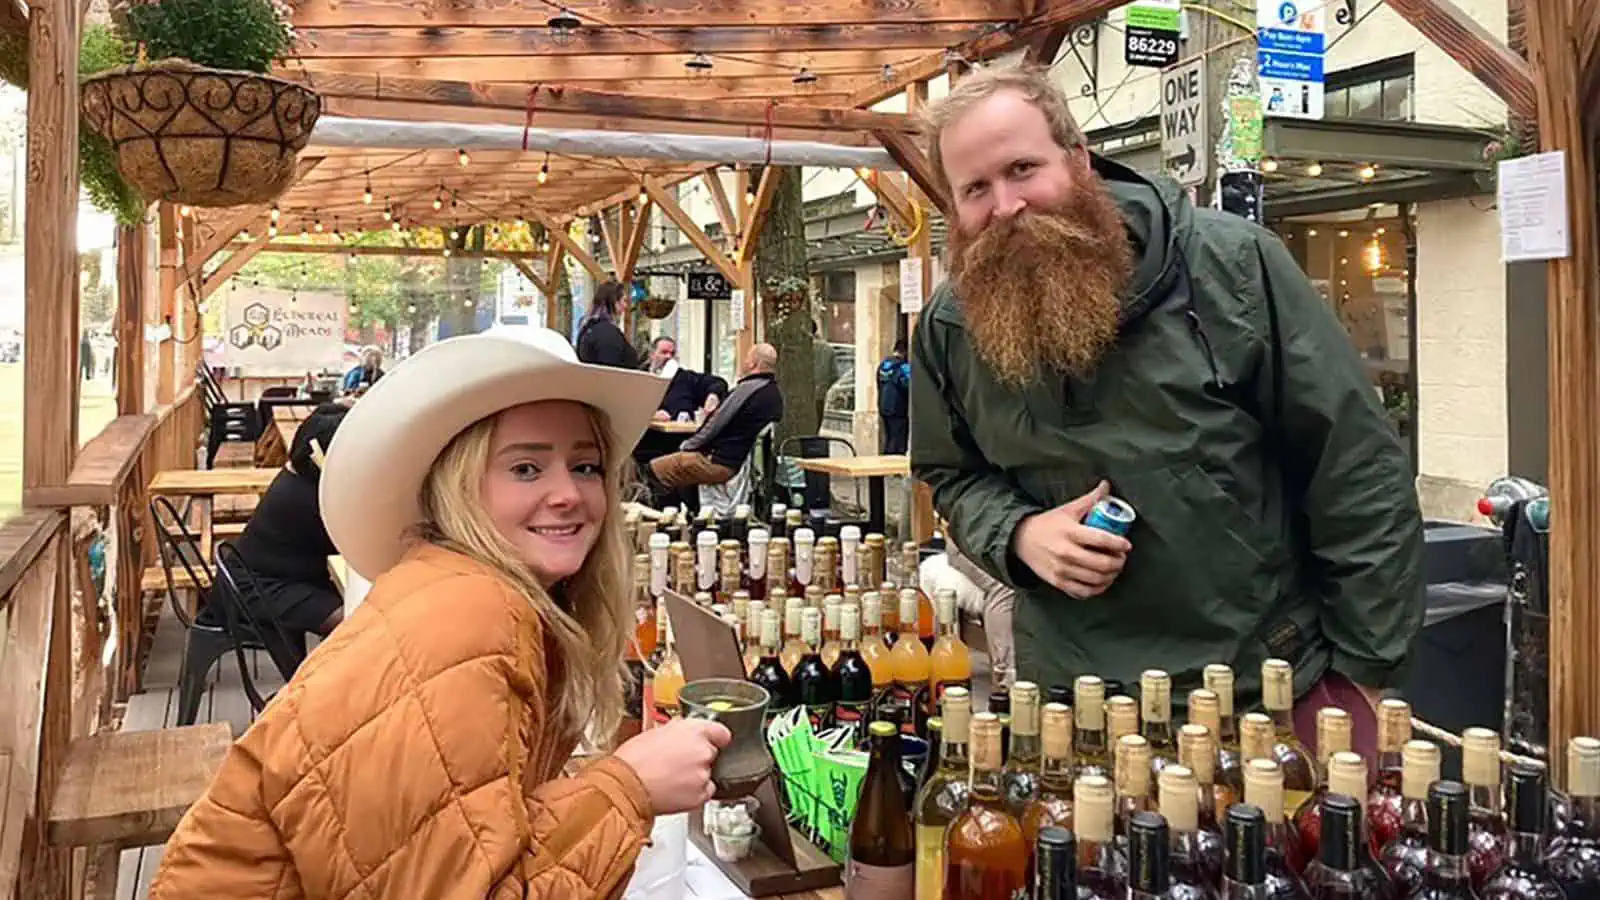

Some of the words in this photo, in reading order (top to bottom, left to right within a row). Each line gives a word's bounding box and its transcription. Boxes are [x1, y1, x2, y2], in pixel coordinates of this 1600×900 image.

[1128, 36, 1176, 56] 86229
[1264, 53, 1271, 67] 2
[1165, 69, 1199, 106] ONE
[1164, 103, 1200, 140] WAY
